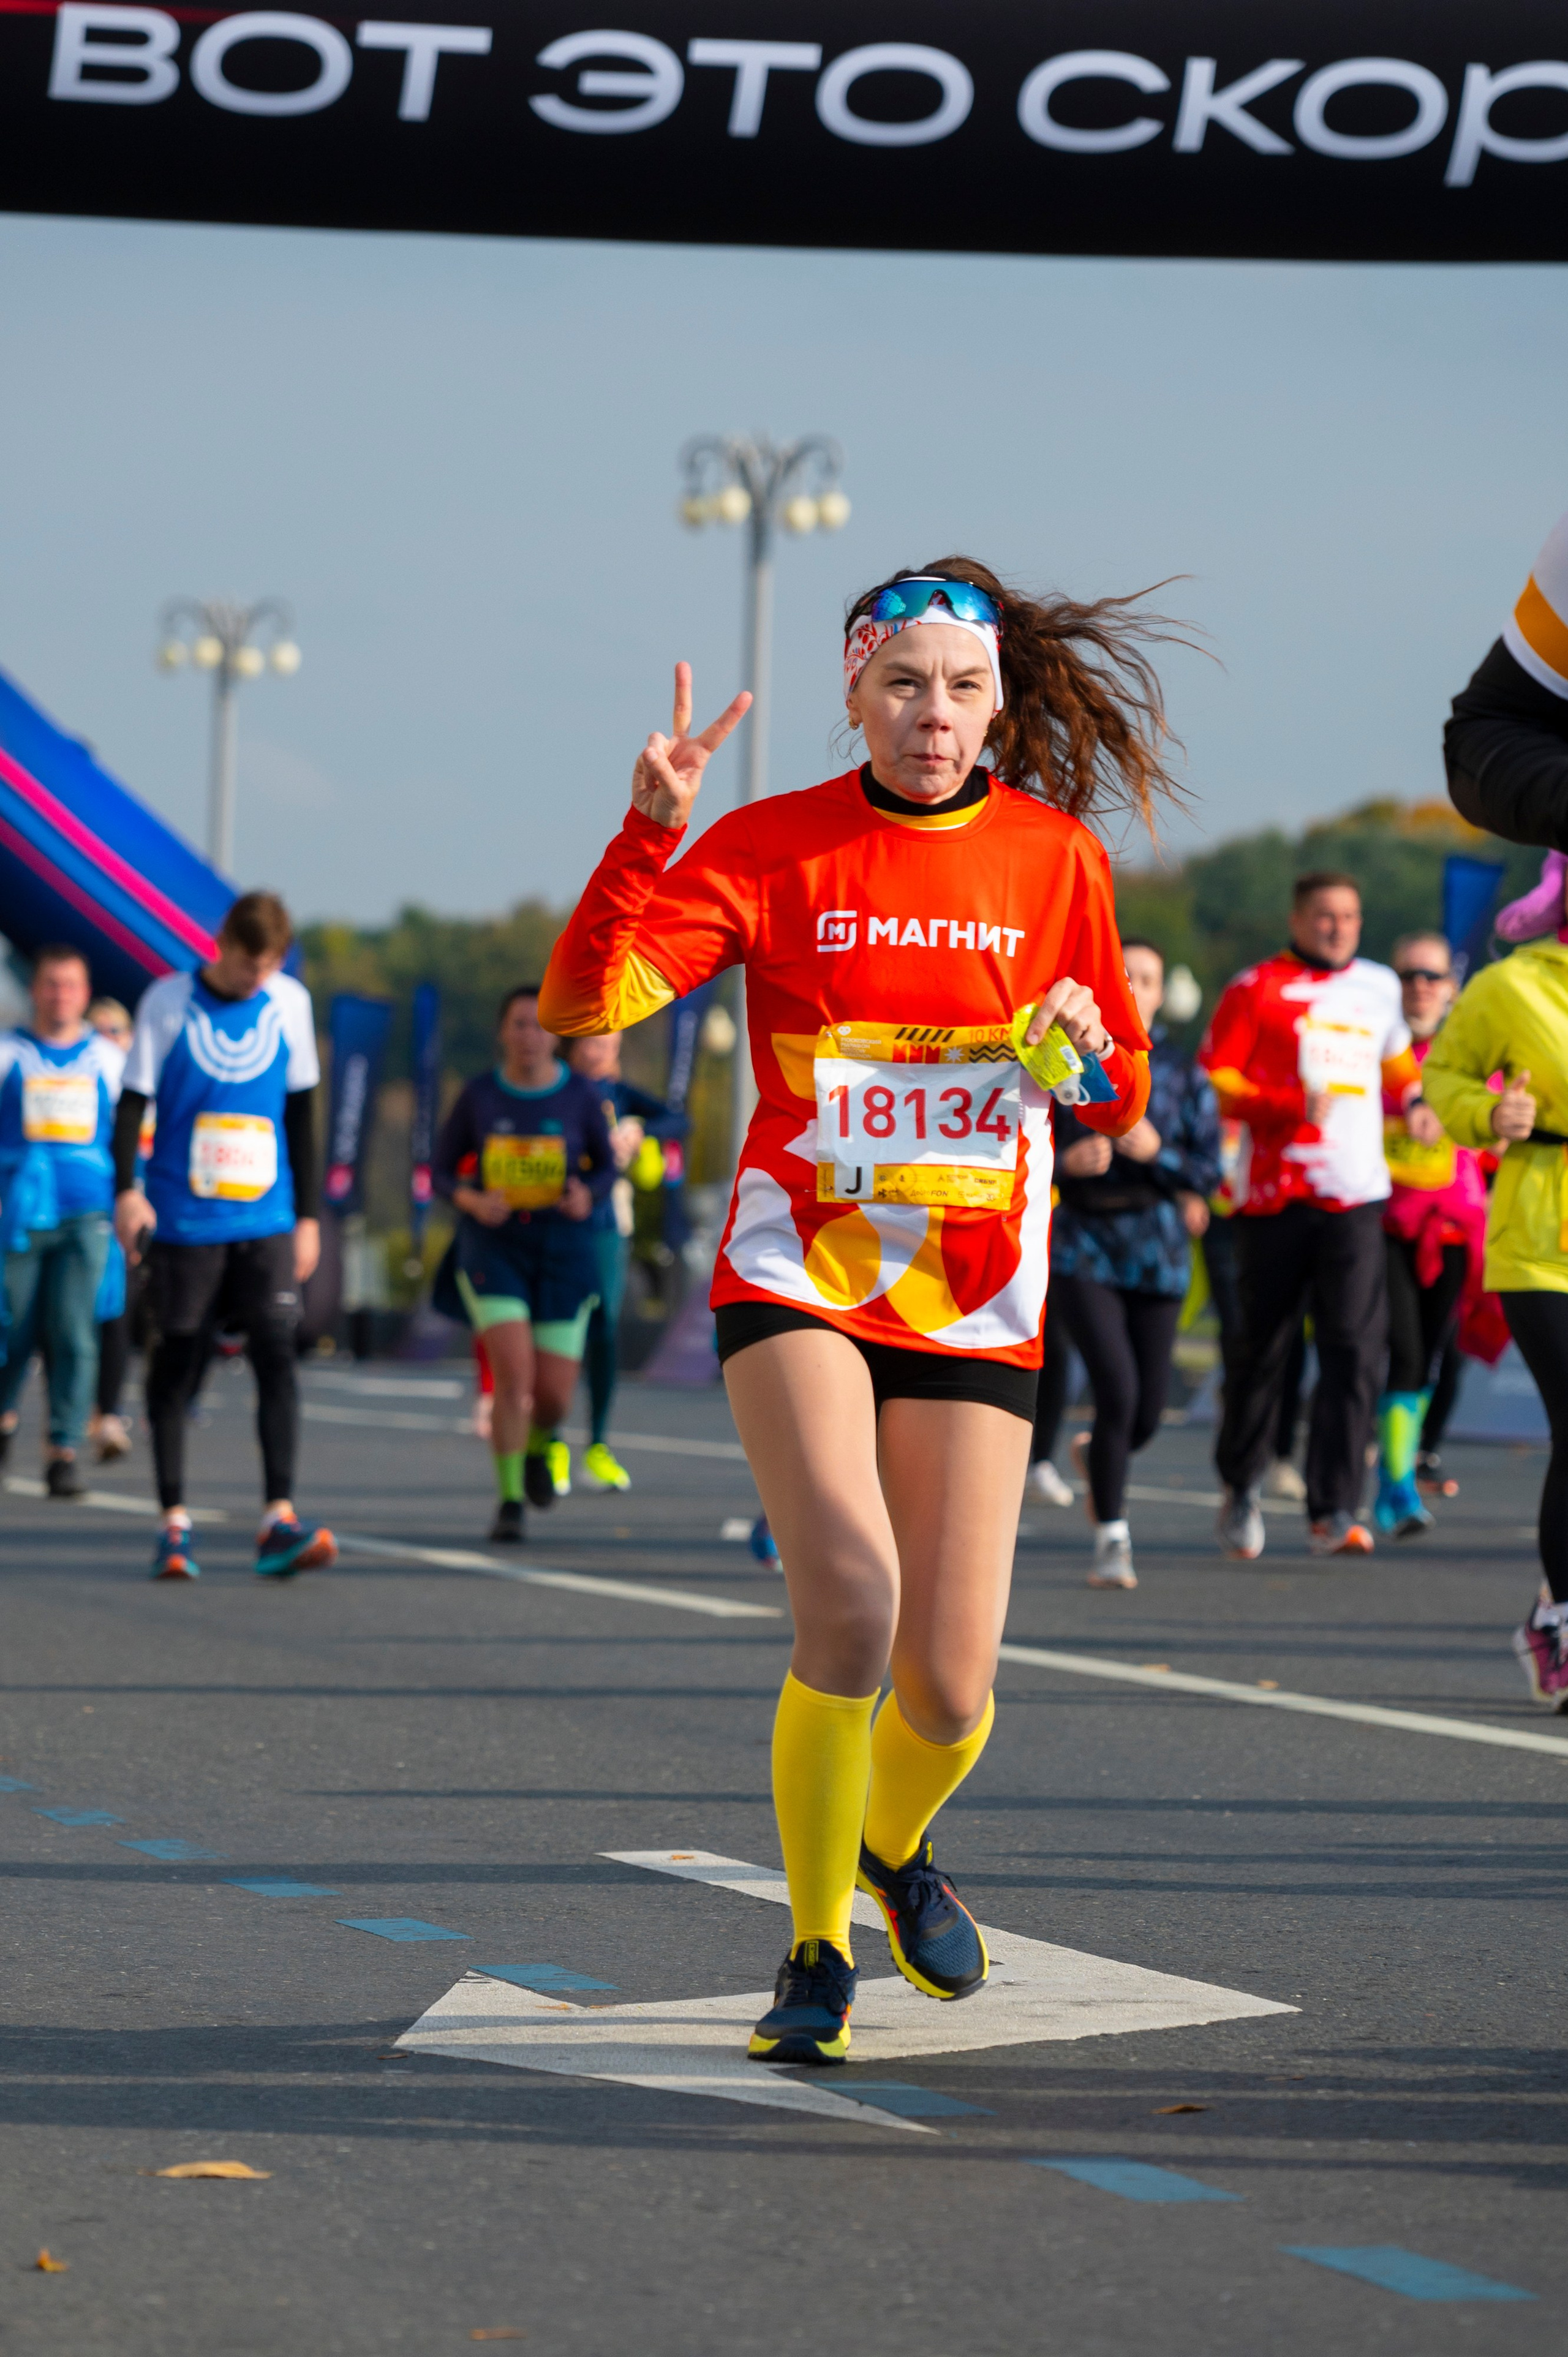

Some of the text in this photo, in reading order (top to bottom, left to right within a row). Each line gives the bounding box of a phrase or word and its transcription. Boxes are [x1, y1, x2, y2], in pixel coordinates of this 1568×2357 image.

[867, 916, 1025, 957] МАГНИТ
[969, 1029, 984, 1043] 10
[829, 1085, 1012, 1142] 18134
[845, 1166, 862, 1194] J
